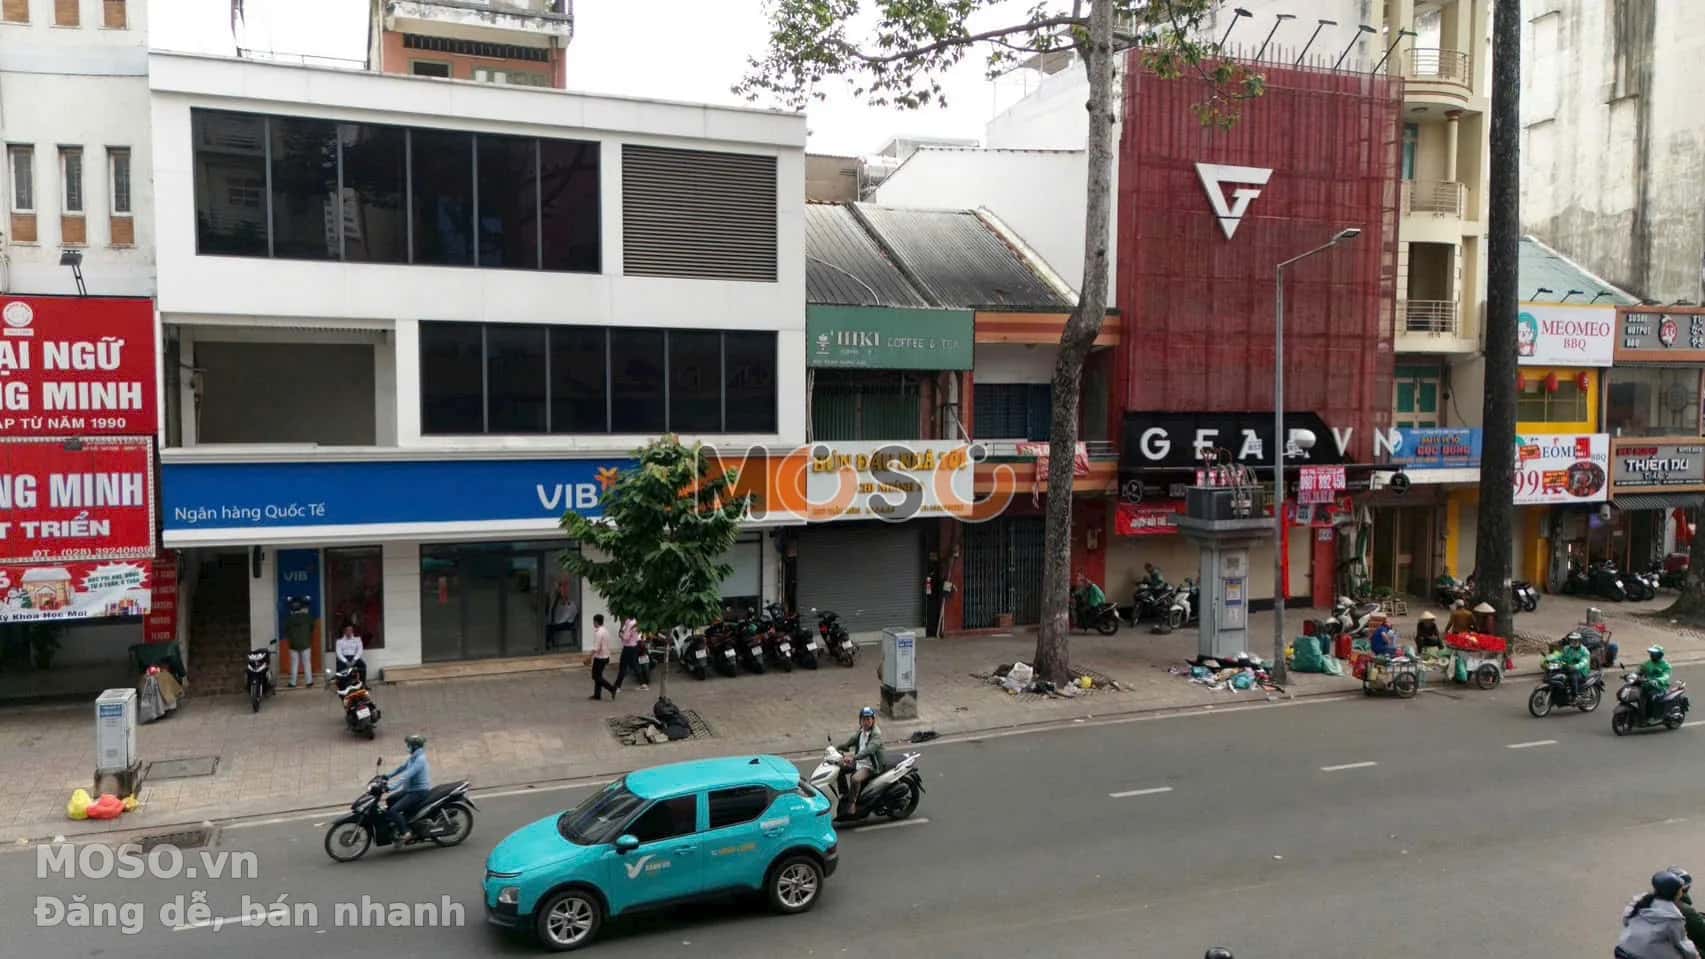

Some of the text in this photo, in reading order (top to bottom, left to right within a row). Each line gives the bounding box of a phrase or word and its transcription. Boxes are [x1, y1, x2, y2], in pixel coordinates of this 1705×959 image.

[1541, 320, 1610, 337] MEOMEO
[43, 336, 125, 370] NGỮ
[887, 338, 924, 348] COFFEE
[942, 339, 961, 349] TEA
[1563, 338, 1587, 351] BBQ
[0, 381, 143, 411] G MINH
[21, 415, 43, 429] TỪ
[48, 416, 85, 429] NĂM
[91, 418, 126, 428] 1990
[50, 473, 143, 508] MINH
[537, 483, 598, 510] VIB
[175, 502, 326, 523] Ngân hàng Quốc Tế
[20, 511, 111, 538] TRIỂN
[283, 571, 308, 582] VIB
